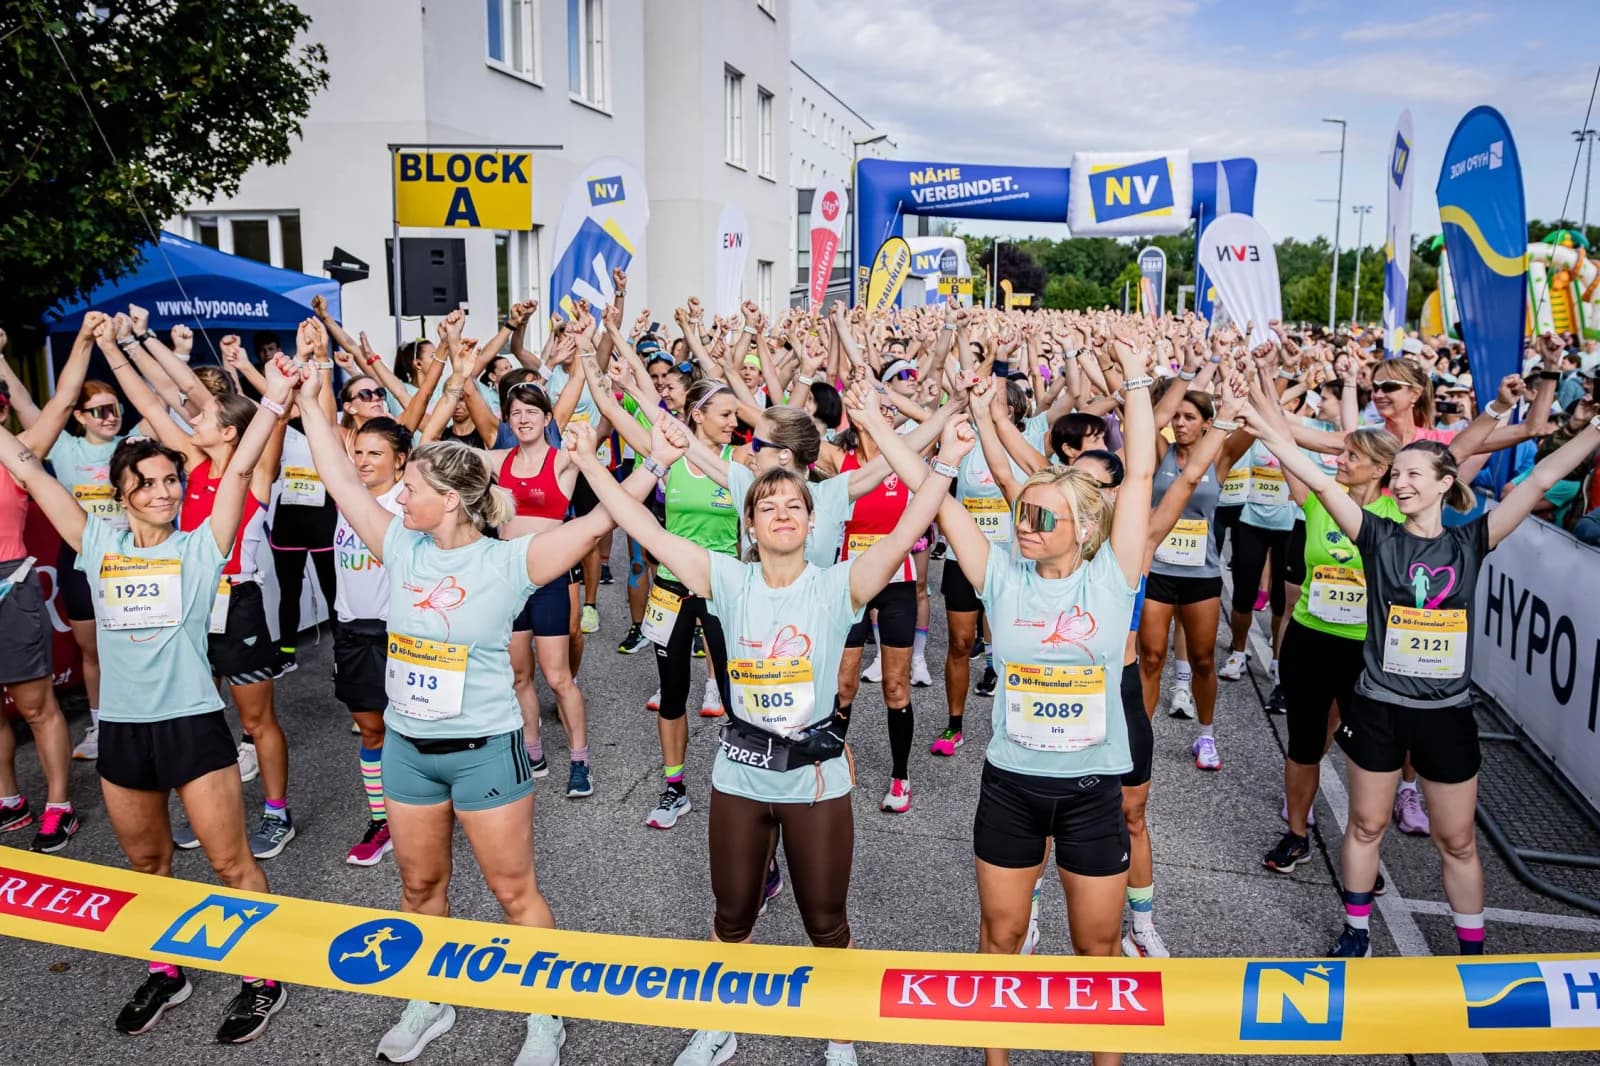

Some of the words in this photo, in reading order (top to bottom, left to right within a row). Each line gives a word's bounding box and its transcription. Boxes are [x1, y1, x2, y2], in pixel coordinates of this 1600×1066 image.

[400, 154, 528, 183] BLOCK
[909, 167, 961, 186] NÄHE
[594, 183, 619, 199] NV
[911, 176, 1019, 203] VERBINDET.
[1105, 175, 1159, 206] NV
[444, 187, 481, 227] A
[723, 232, 743, 249] EVN
[916, 255, 941, 270] NV
[877, 248, 909, 310] FRAUENLAUF
[939, 276, 971, 285] BLOCK
[951, 285, 960, 294] B
[156, 297, 269, 319] www.hyponoe.at
[293, 481, 316, 491] 2253
[1258, 482, 1280, 492] 2036
[974, 516, 999, 526] 1858
[1170, 536, 1197, 548] 2118
[340, 551, 382, 571] RUN
[115, 583, 160, 599] 1923
[1328, 589, 1365, 603] 2137
[123, 605, 152, 613] Kathrin
[1484, 564, 1577, 705] HYPO
[1410, 637, 1449, 651] 2121
[1417, 656, 1442, 664] Jasmin
[406, 671, 438, 690] 513
[410, 694, 430, 704] Anita
[753, 692, 794, 709] 1805
[1032, 702, 1084, 718] 2089
[762, 714, 787, 723] Kerstin
[1051, 726, 1065, 734] Iris
[719, 736, 773, 769] ERREX
[0, 875, 112, 922] RIER
[427, 937, 813, 1007] NÖ-Frauenlauf
[897, 974, 1149, 1012] KURIER
